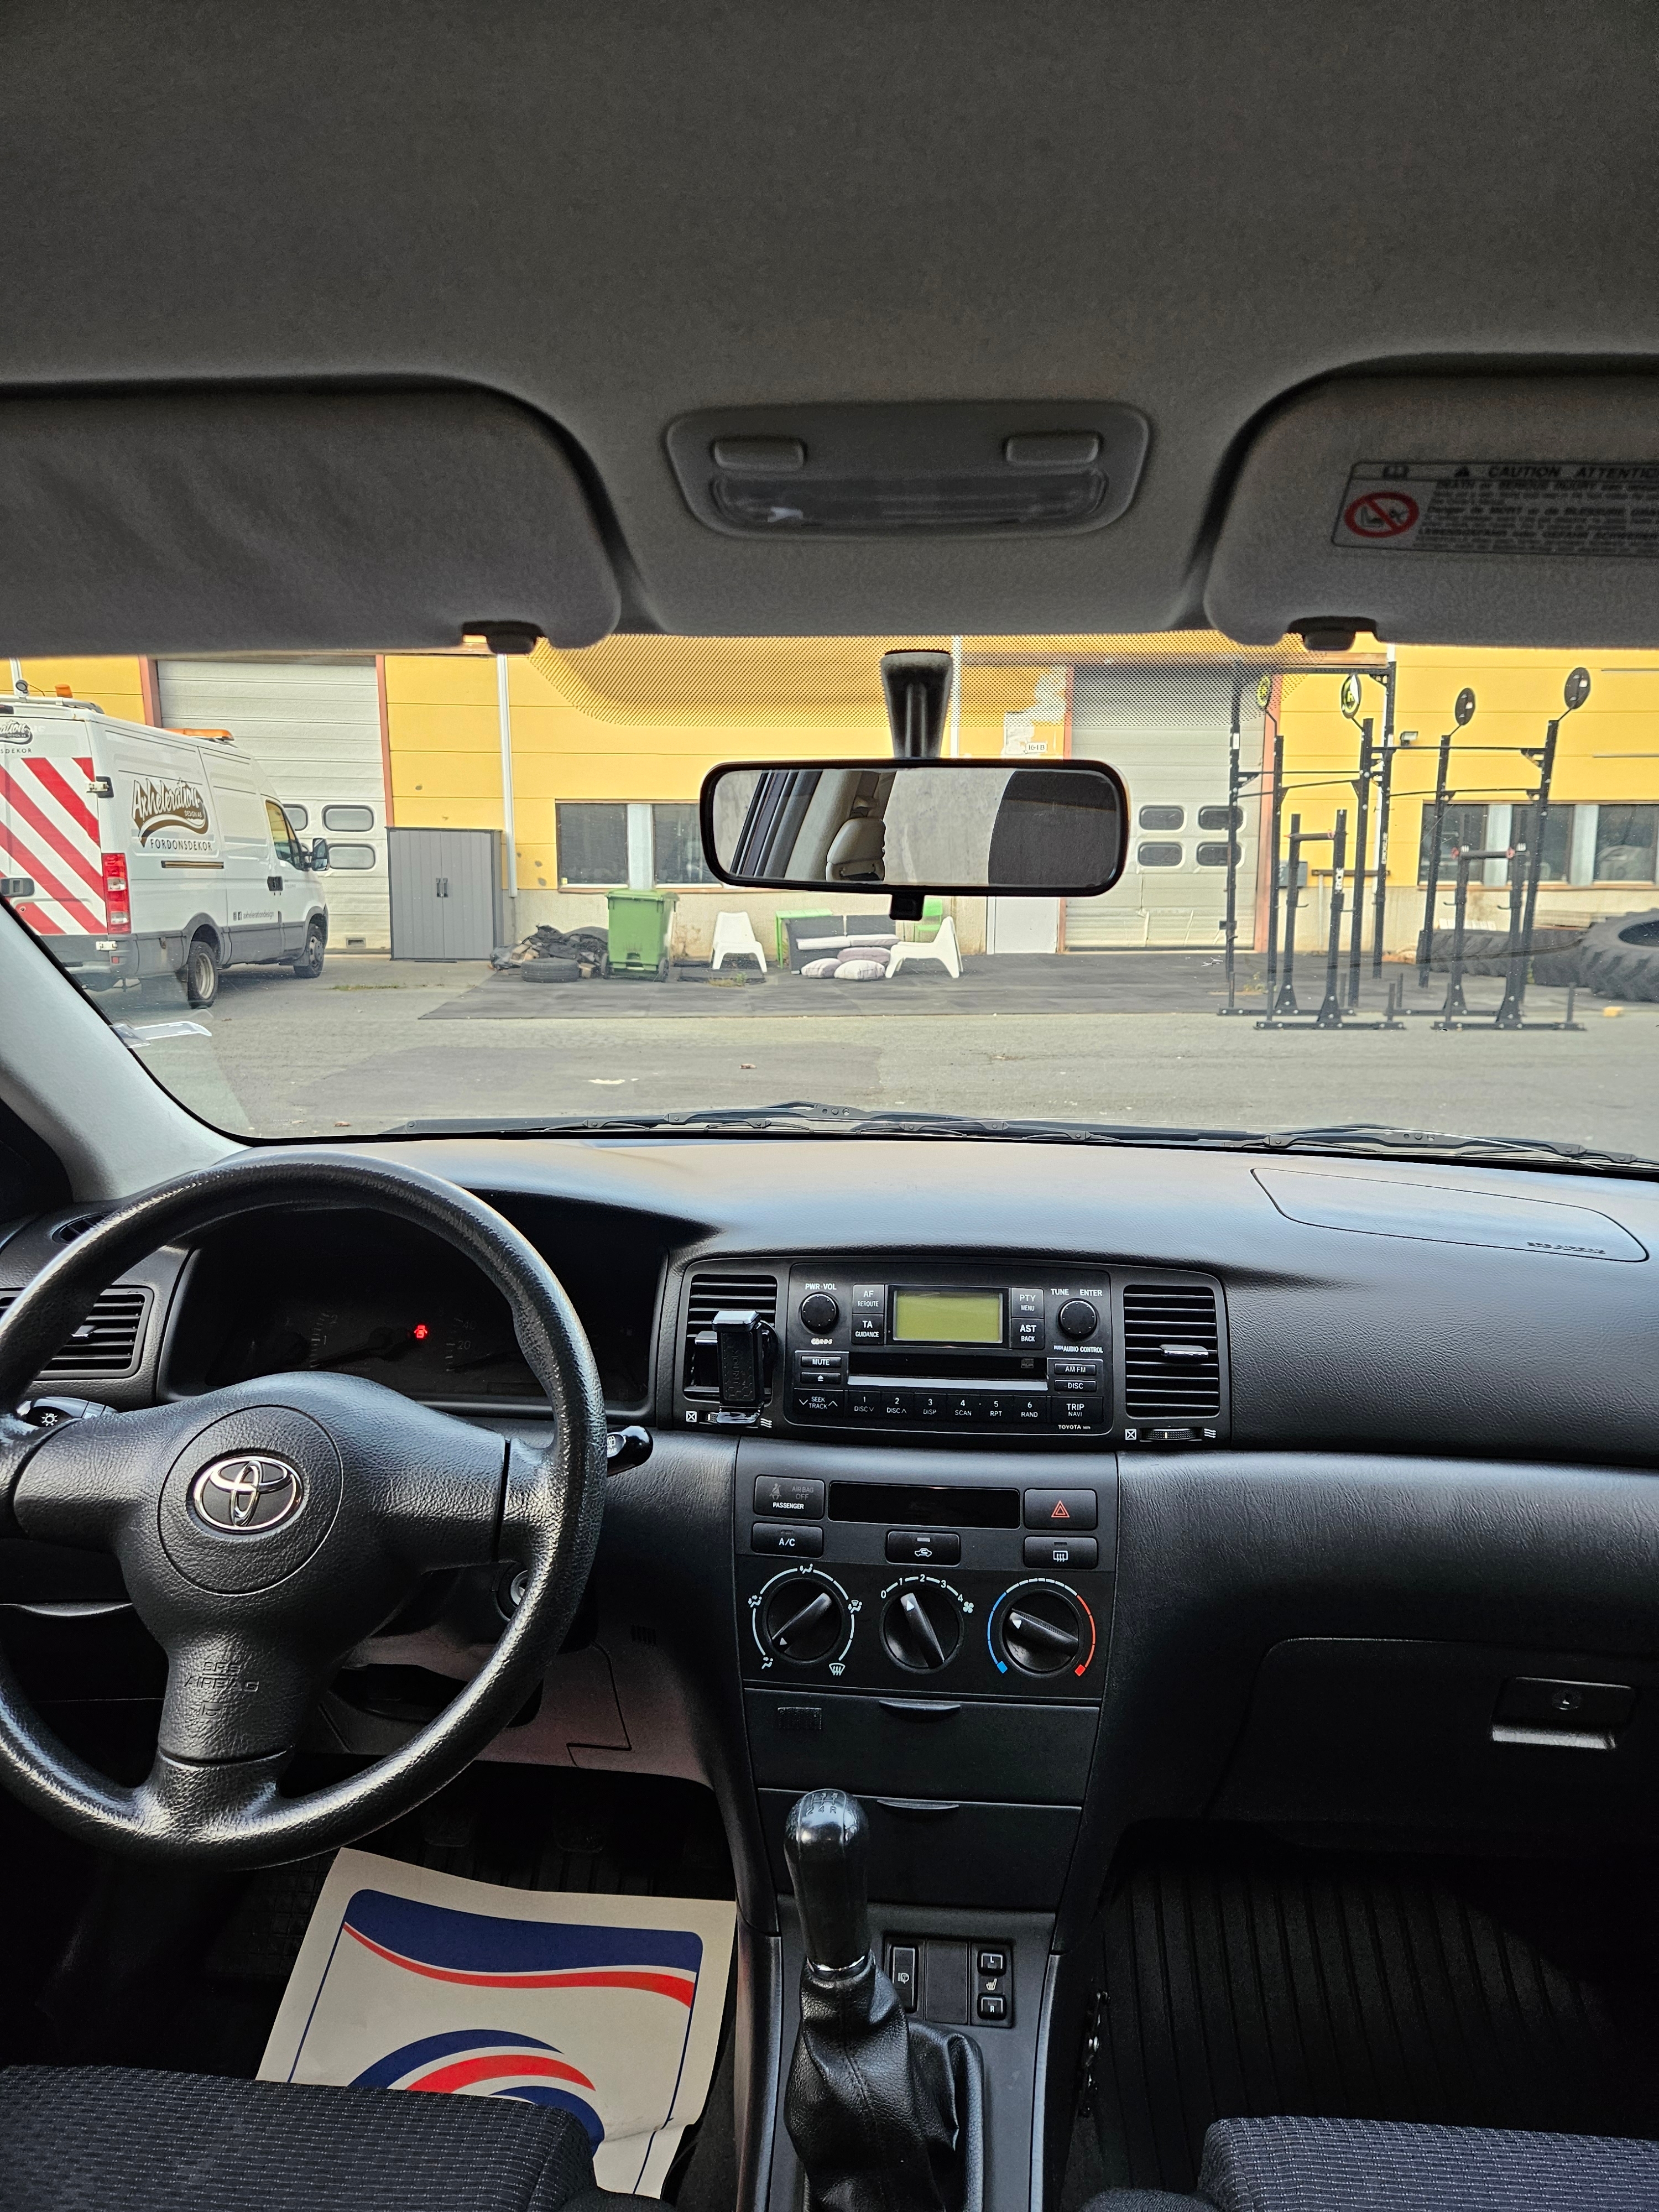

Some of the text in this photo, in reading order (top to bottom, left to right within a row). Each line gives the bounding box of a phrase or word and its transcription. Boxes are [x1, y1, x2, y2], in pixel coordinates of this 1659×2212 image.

[1488, 466, 1561, 478] CAUTION
[150, 838, 212, 851] FORDONSDEKOR
[1020, 1324, 1037, 1333] AST
[457, 1340, 471, 1350] 20
[779, 1537, 795, 1547] A/C
[920, 1574, 926, 1582] 2
[941, 1580, 947, 1588] 3
[880, 1590, 886, 1599] 0
[957, 1594, 963, 1602] 4
